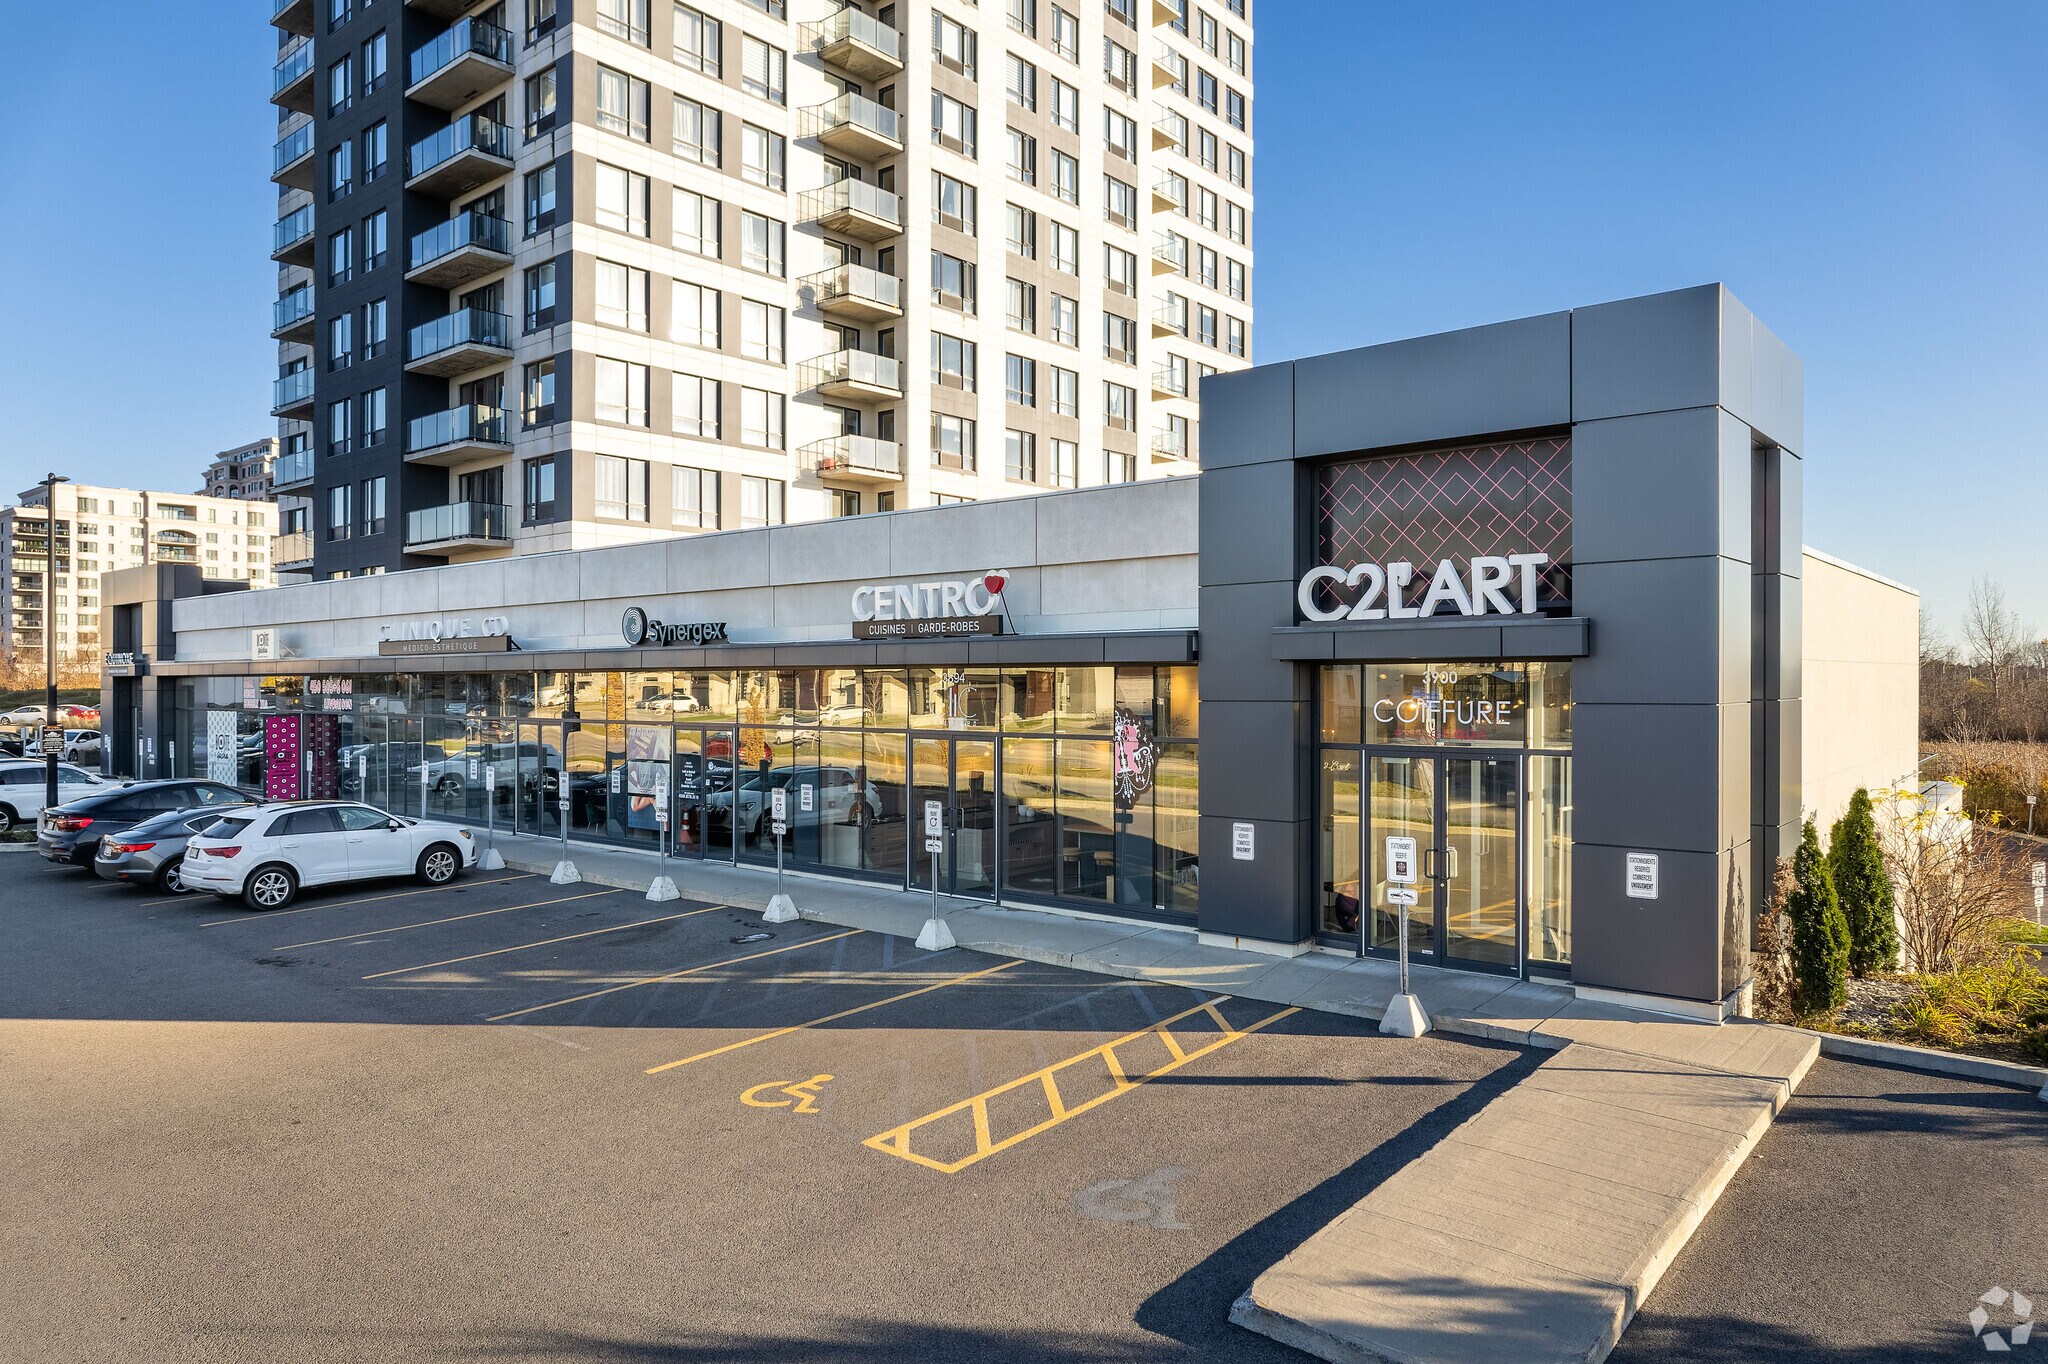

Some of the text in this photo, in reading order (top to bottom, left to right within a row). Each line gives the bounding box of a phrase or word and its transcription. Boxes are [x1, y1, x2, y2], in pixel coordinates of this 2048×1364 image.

[851, 575, 1000, 621] CENTRO
[379, 620, 474, 643] CINIQUE
[648, 620, 727, 647] Synergex
[869, 620, 980, 635] CUISINES GARDE-ROBES
[1422, 671, 1458, 684] 3900
[1373, 699, 1511, 725] COIFFURE
